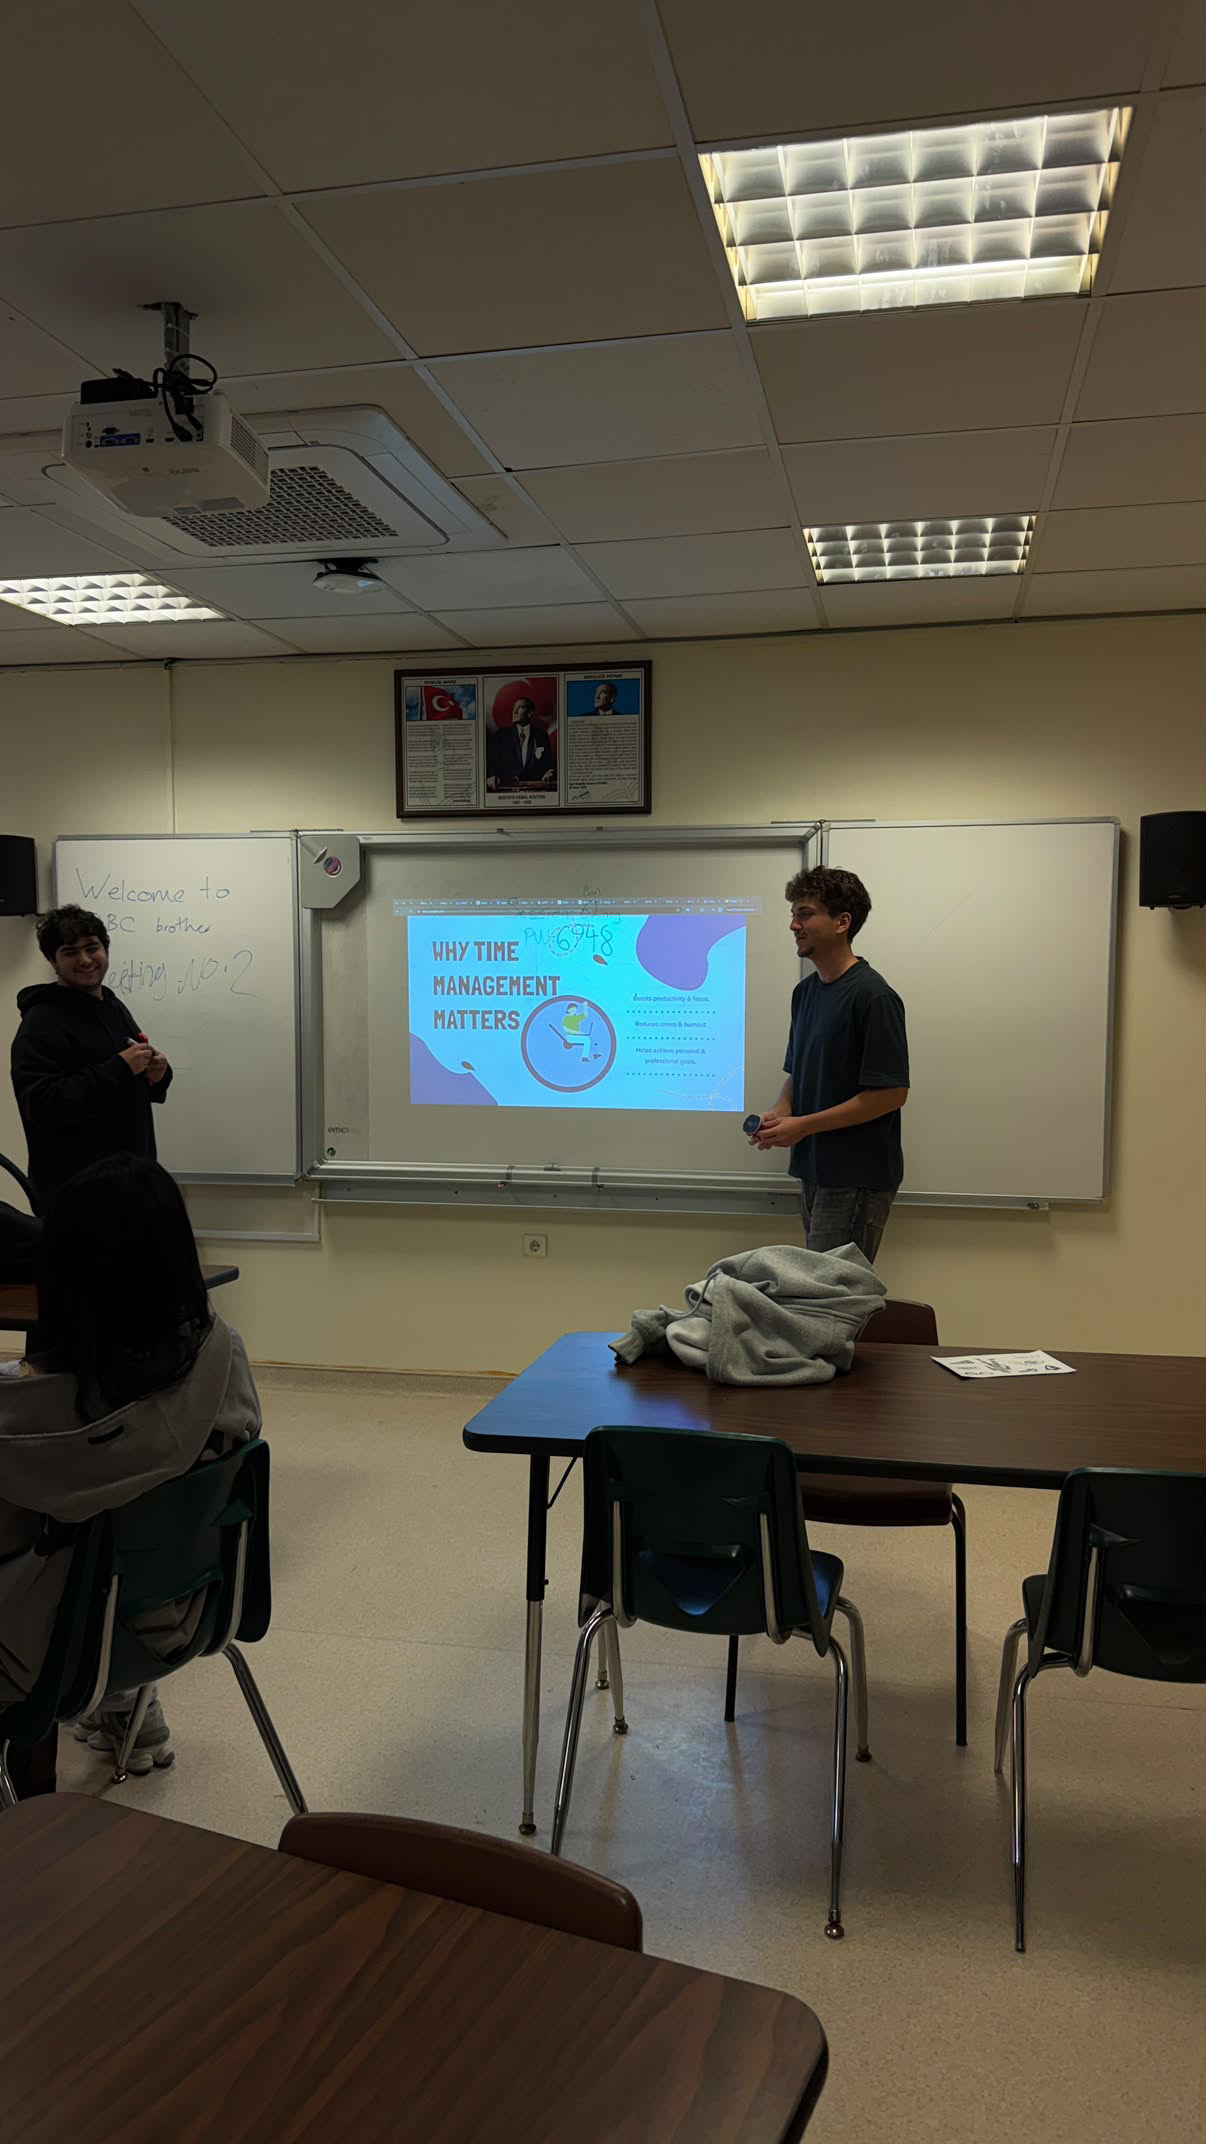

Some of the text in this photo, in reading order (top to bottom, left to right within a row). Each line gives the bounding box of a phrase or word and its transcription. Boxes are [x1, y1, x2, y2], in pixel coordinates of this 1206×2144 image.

[75, 867, 231, 902] Welcome to
[432, 941, 520, 961] WHY TIME
[556, 923, 613, 957] 6948
[108, 959, 168, 1001] eeting
[433, 975, 560, 996] MANAGEMENT
[433, 1009, 520, 1030] MATTERS
